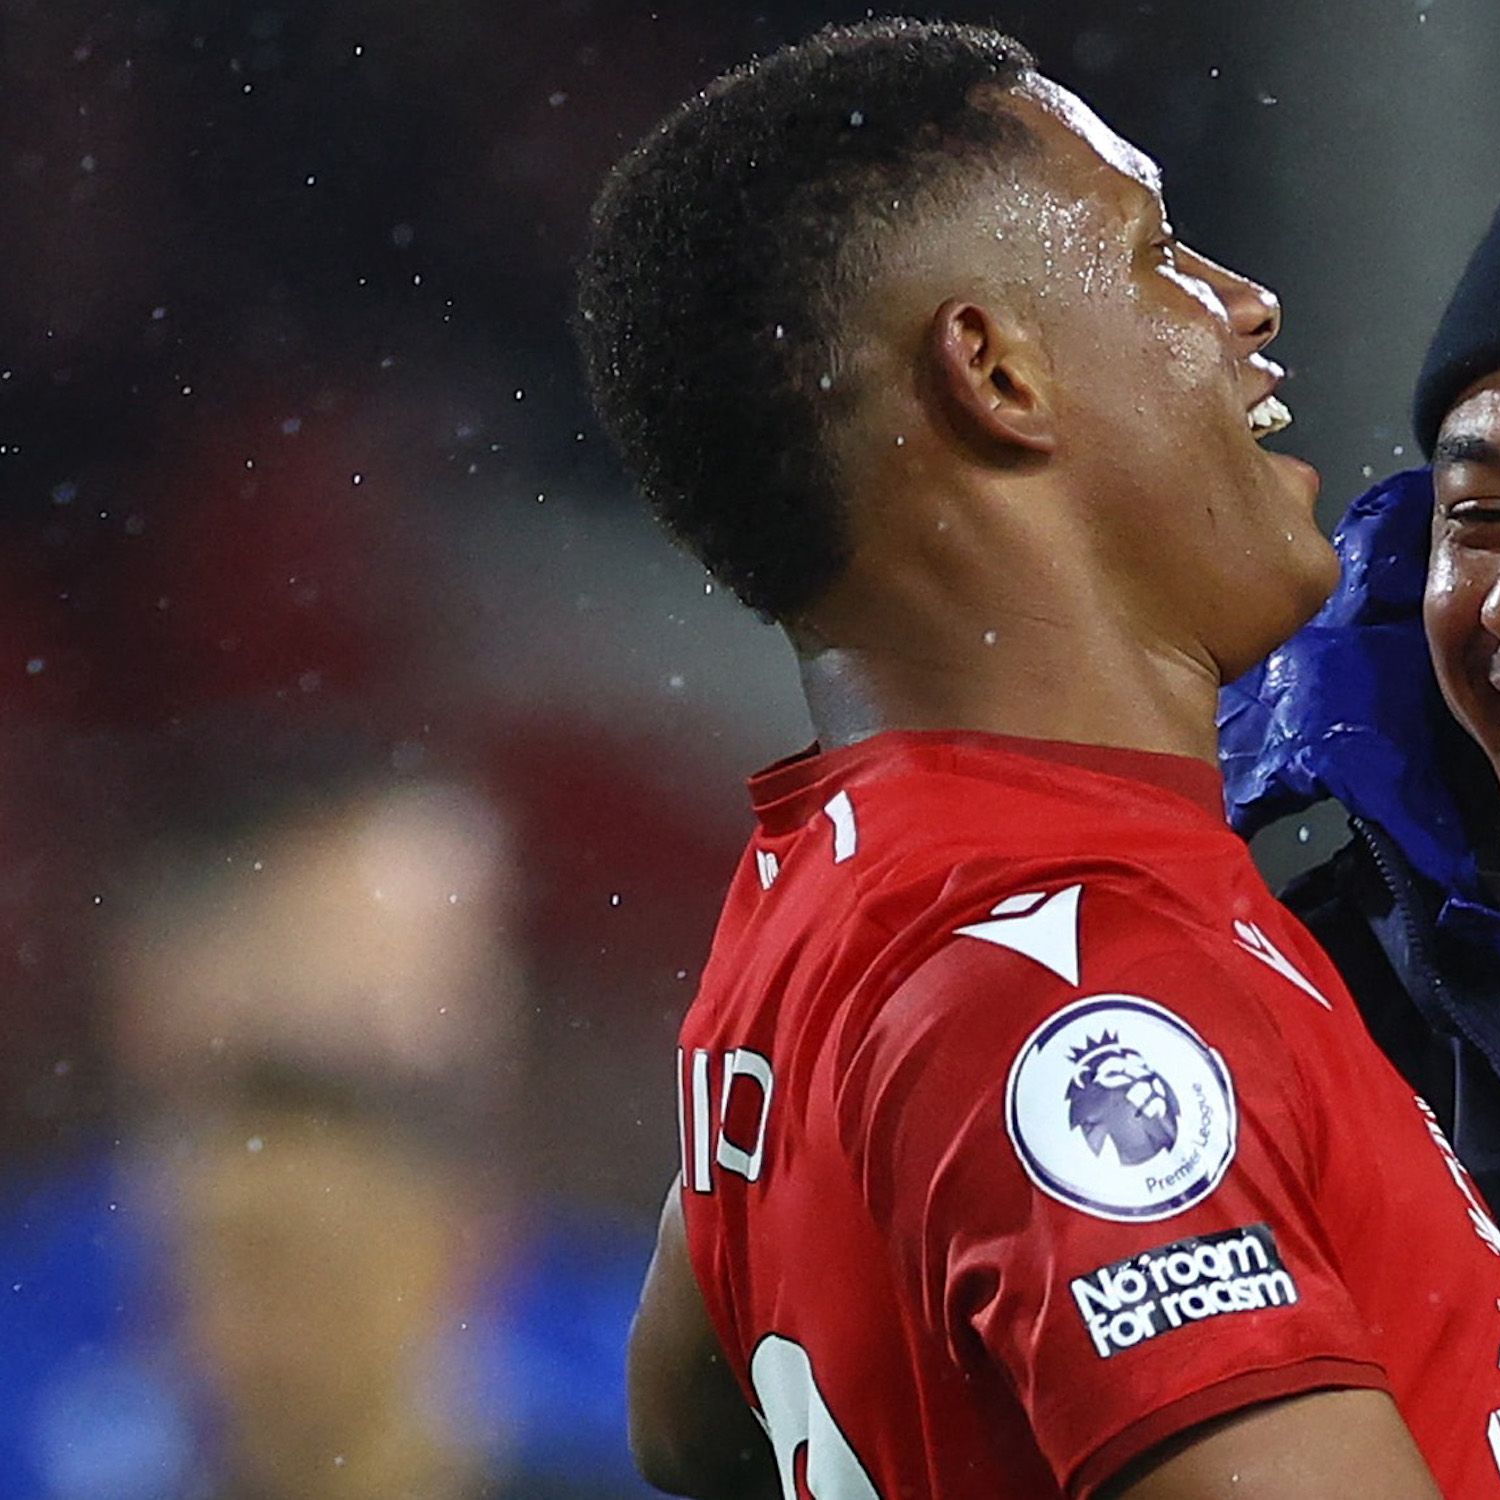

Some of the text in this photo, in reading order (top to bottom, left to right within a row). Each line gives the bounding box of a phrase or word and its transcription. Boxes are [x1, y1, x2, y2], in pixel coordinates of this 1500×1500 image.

[1145, 1083, 1214, 1193] Premier League
[1071, 1235, 1268, 1322] No room
[1089, 1270, 1298, 1358] for racism
